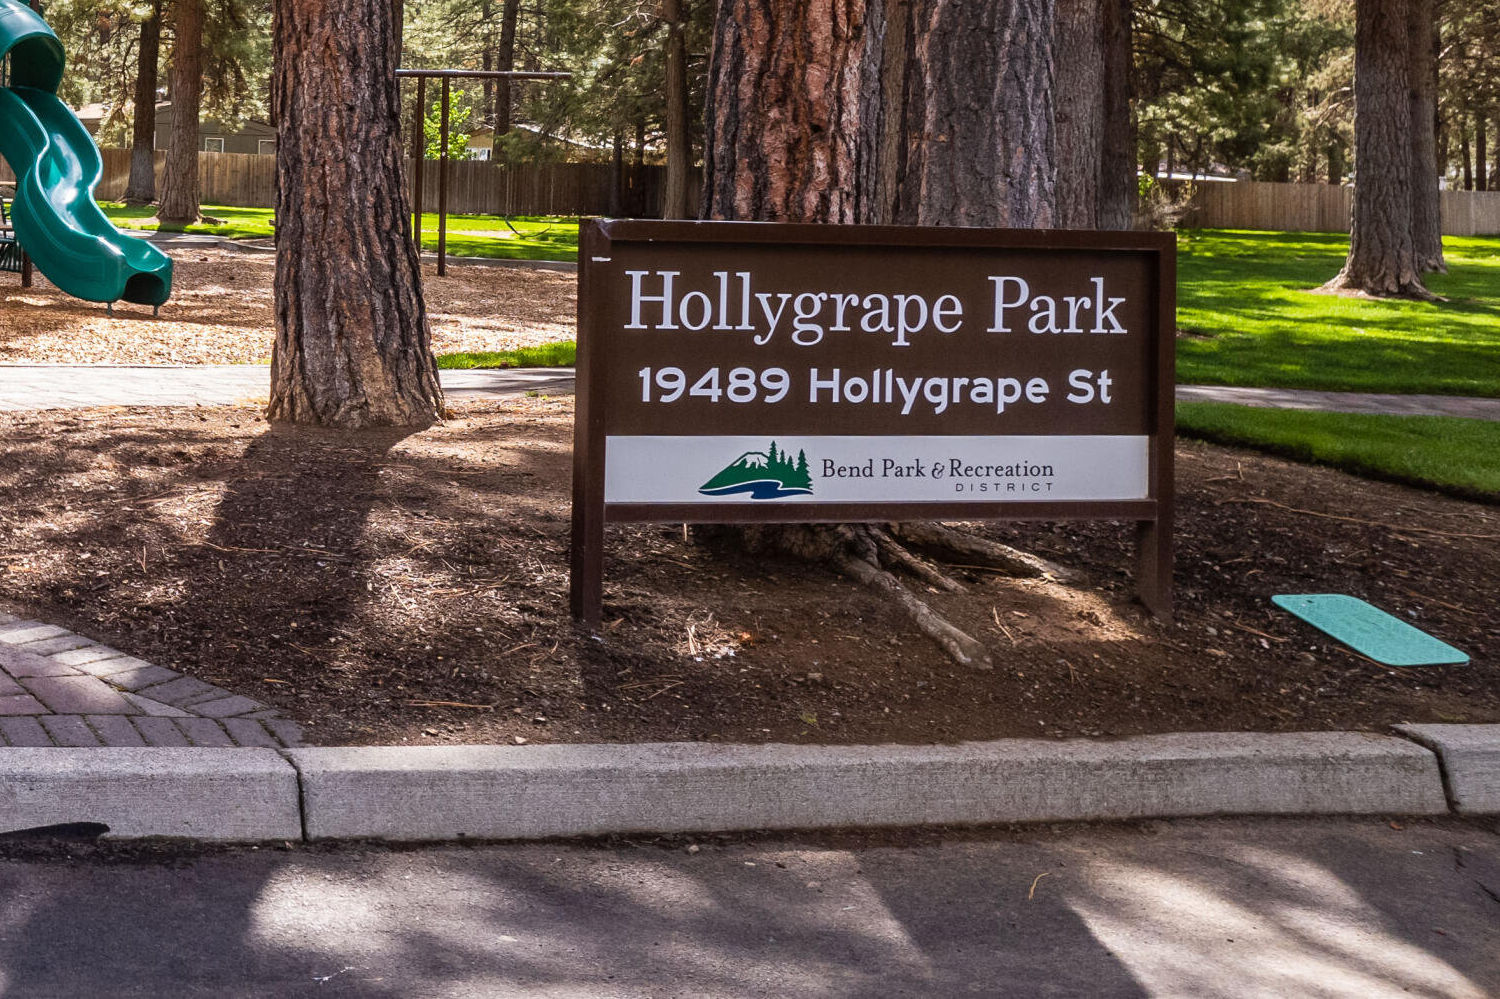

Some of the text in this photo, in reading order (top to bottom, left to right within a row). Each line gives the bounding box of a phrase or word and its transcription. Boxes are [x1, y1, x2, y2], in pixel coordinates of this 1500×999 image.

[623, 270, 1128, 347] Hollygrape Park
[638, 366, 1113, 415] 19489 Hollygrape St
[820, 458, 1055, 479] Bend Park & Recreation
[955, 482, 1053, 492] DISTRICT
